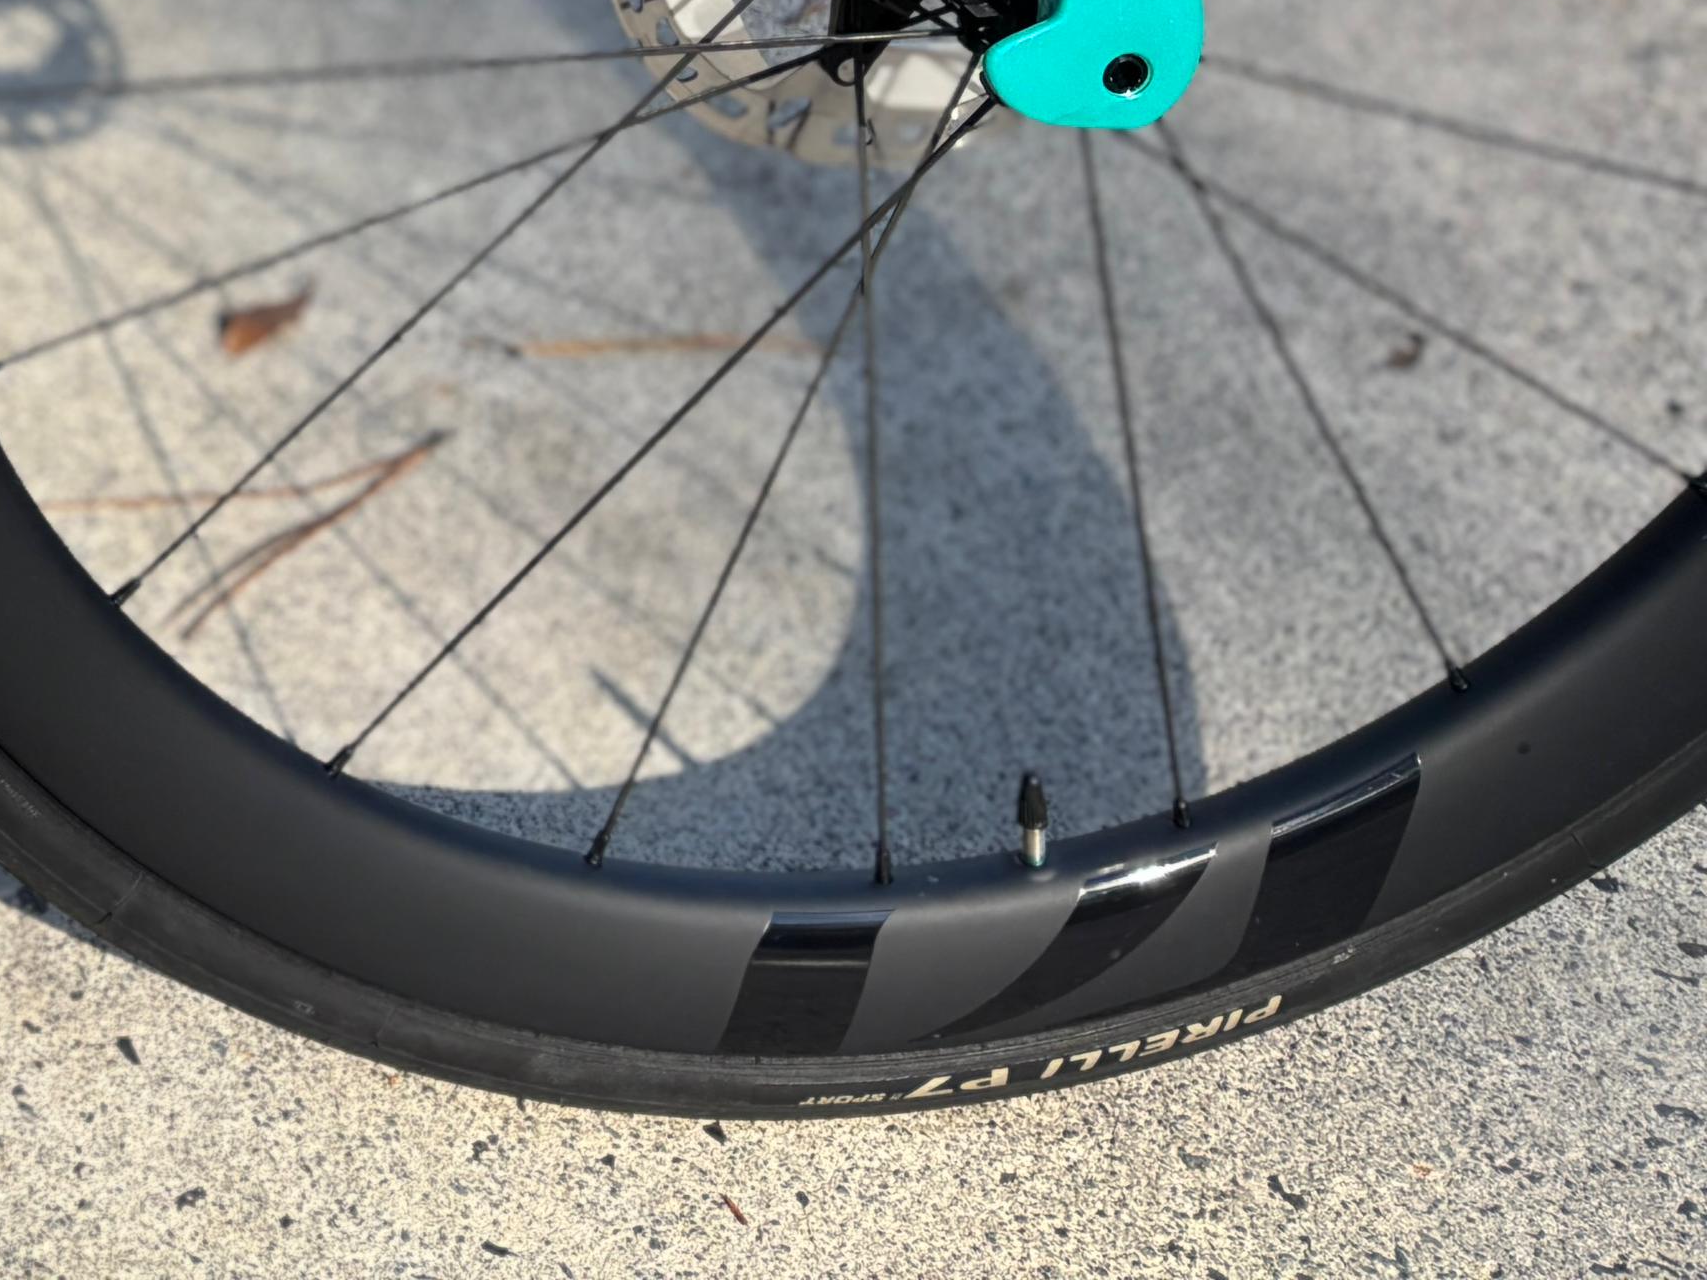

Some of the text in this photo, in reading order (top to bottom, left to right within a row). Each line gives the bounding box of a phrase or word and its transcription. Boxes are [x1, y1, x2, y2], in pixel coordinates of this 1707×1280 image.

[798, 994, 1283, 1107] PIRELLI P7 SPORT
